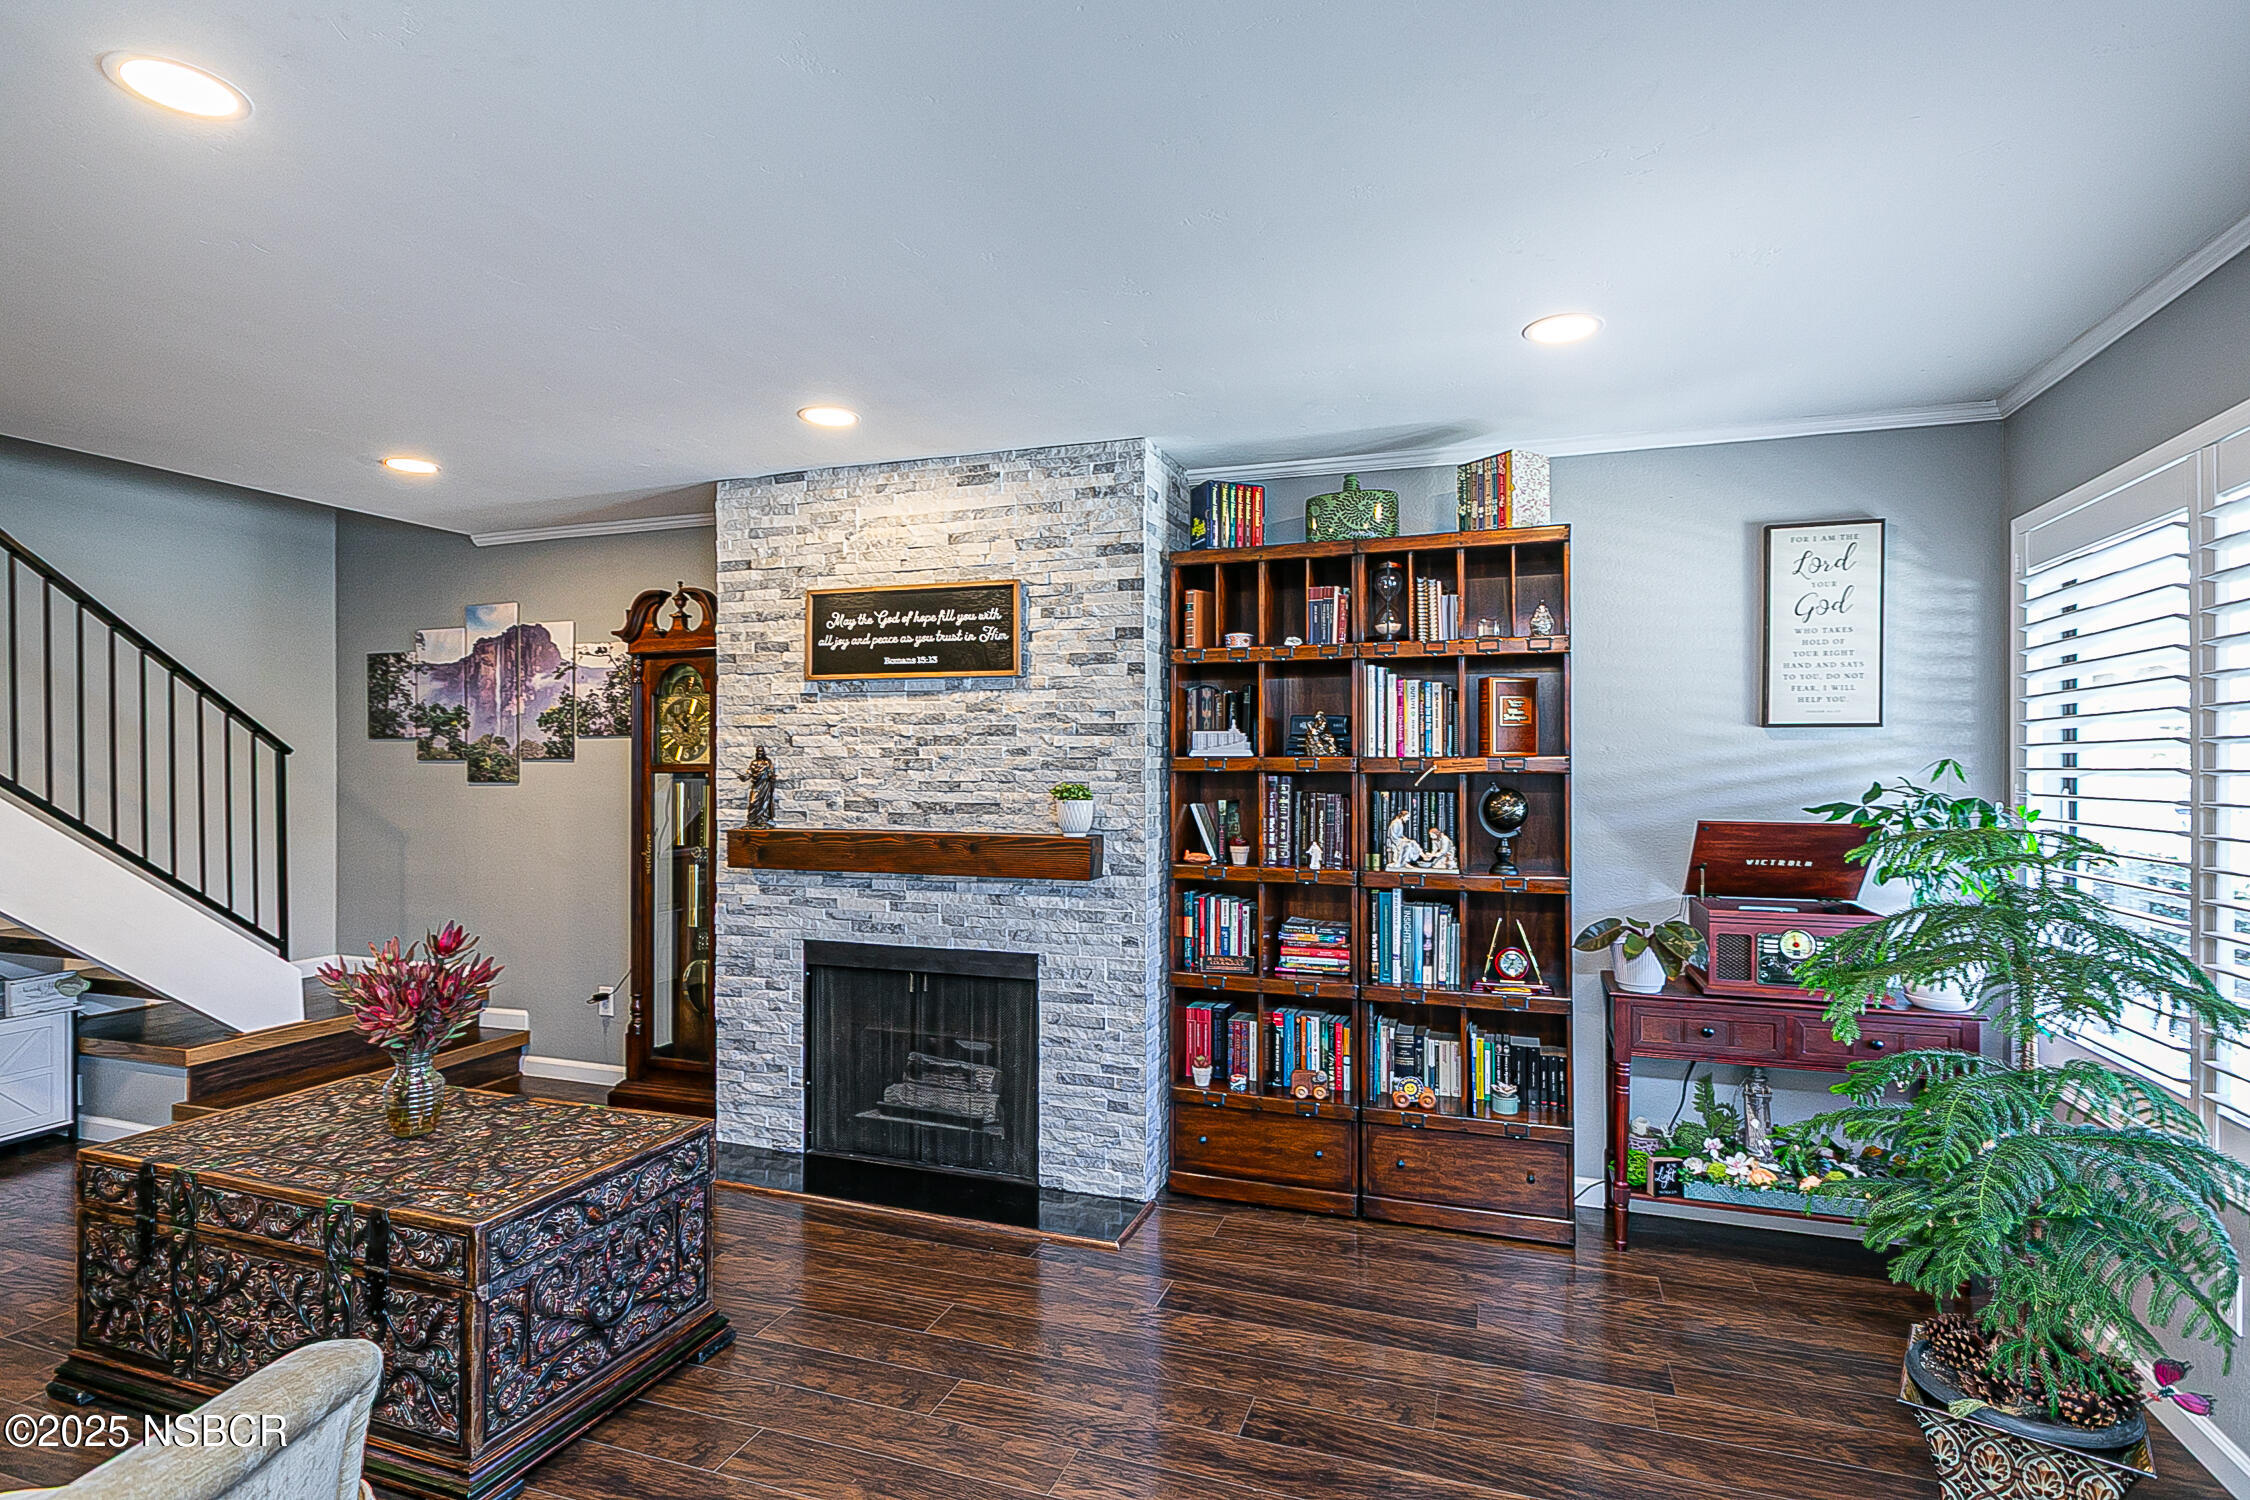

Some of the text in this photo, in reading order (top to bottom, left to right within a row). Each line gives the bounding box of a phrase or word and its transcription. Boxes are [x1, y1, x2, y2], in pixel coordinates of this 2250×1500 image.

[1792, 542, 1857, 580] Lord
[826, 608, 1002, 630] May the God of hope fill you with
[1794, 585, 1855, 623] God
[818, 625, 1009, 650] all joy and peace as you trust in Him
[1403, 910, 1412, 944] INSIGHTS
